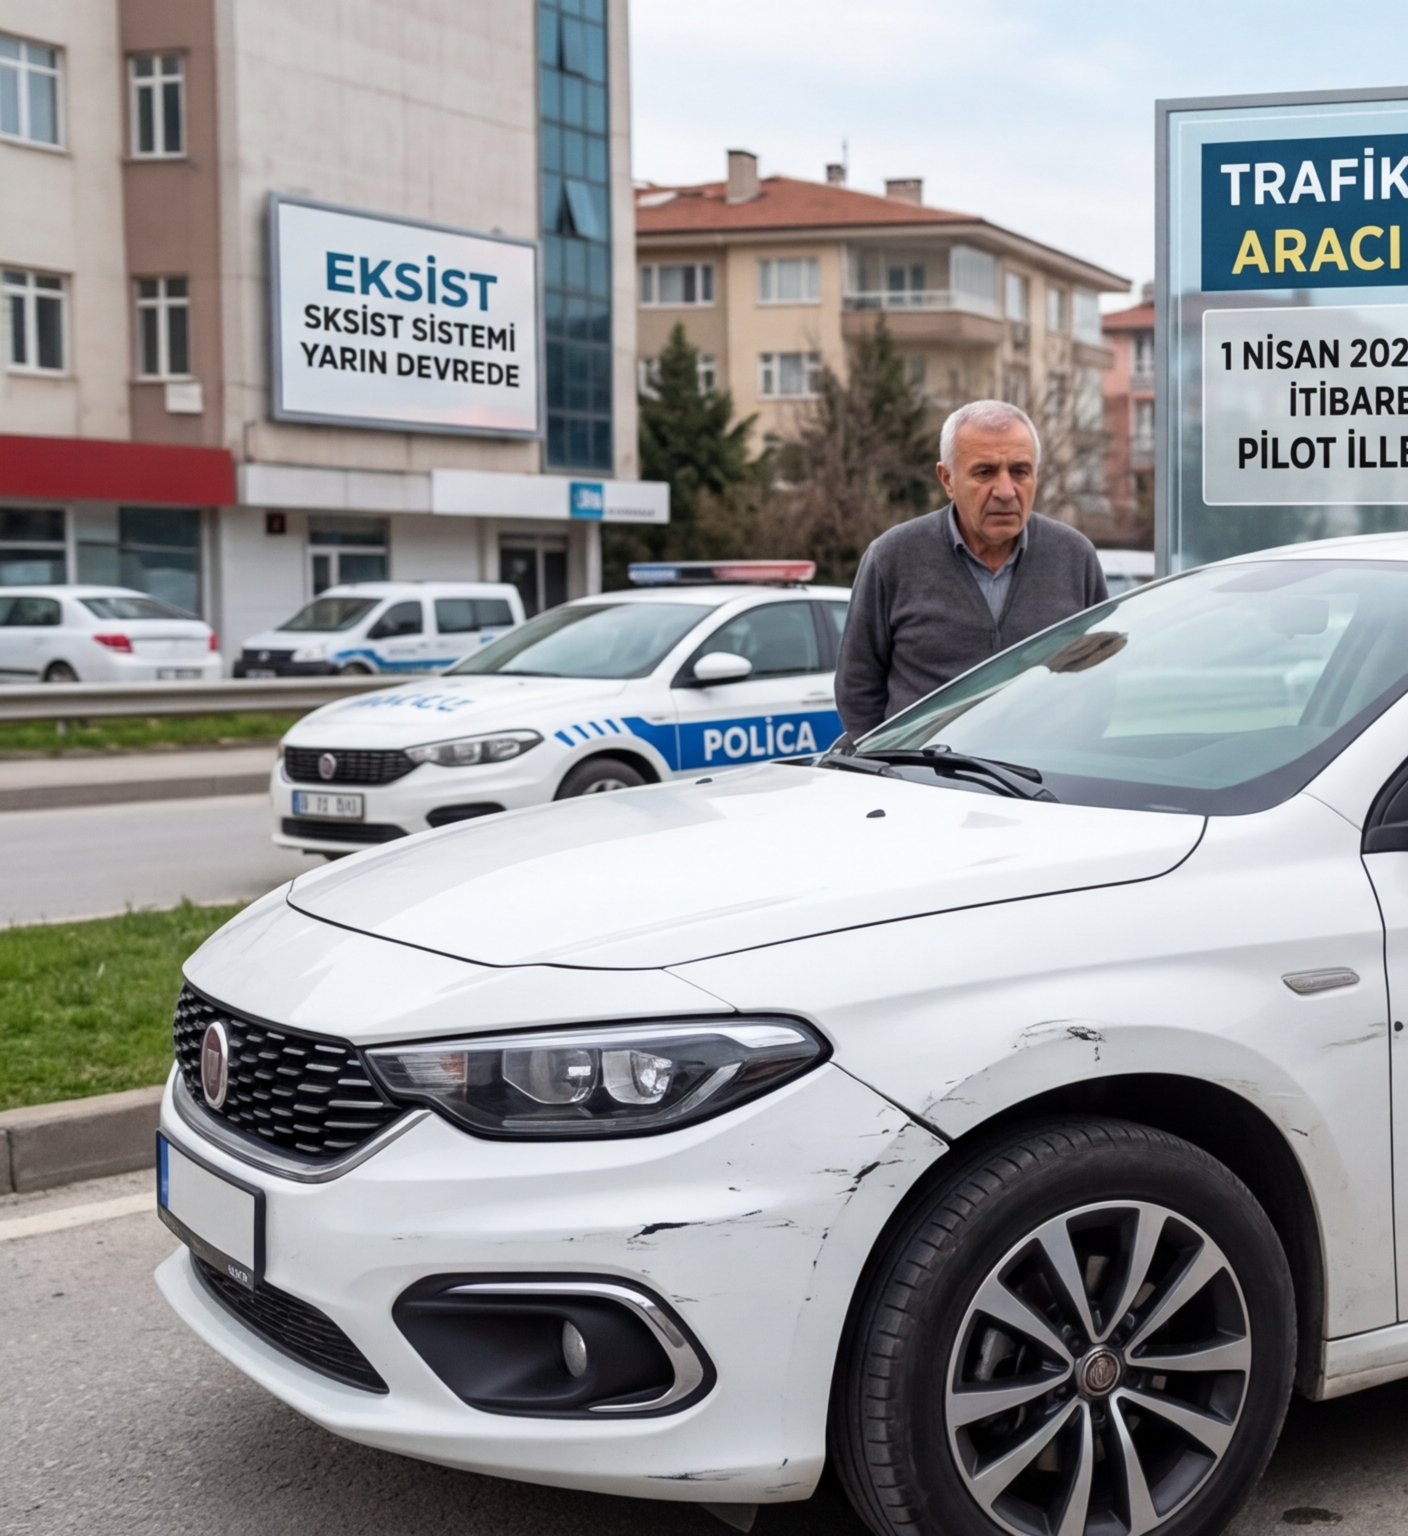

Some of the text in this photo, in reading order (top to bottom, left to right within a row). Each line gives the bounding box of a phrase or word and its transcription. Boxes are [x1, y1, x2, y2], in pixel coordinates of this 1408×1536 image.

[1231, 225, 1401, 275] ARACI
[325, 251, 498, 312] EKSİST
[304, 303, 515, 352] SKSİST SİSTEMİ
[300, 341, 520, 388] YARIN DEVREDE
[1221, 341, 1232, 371] 1
[1243, 333, 1340, 371] NİSAN
[1238, 429, 1337, 470] PİLOT
[703, 715, 818, 761] POLİCA
